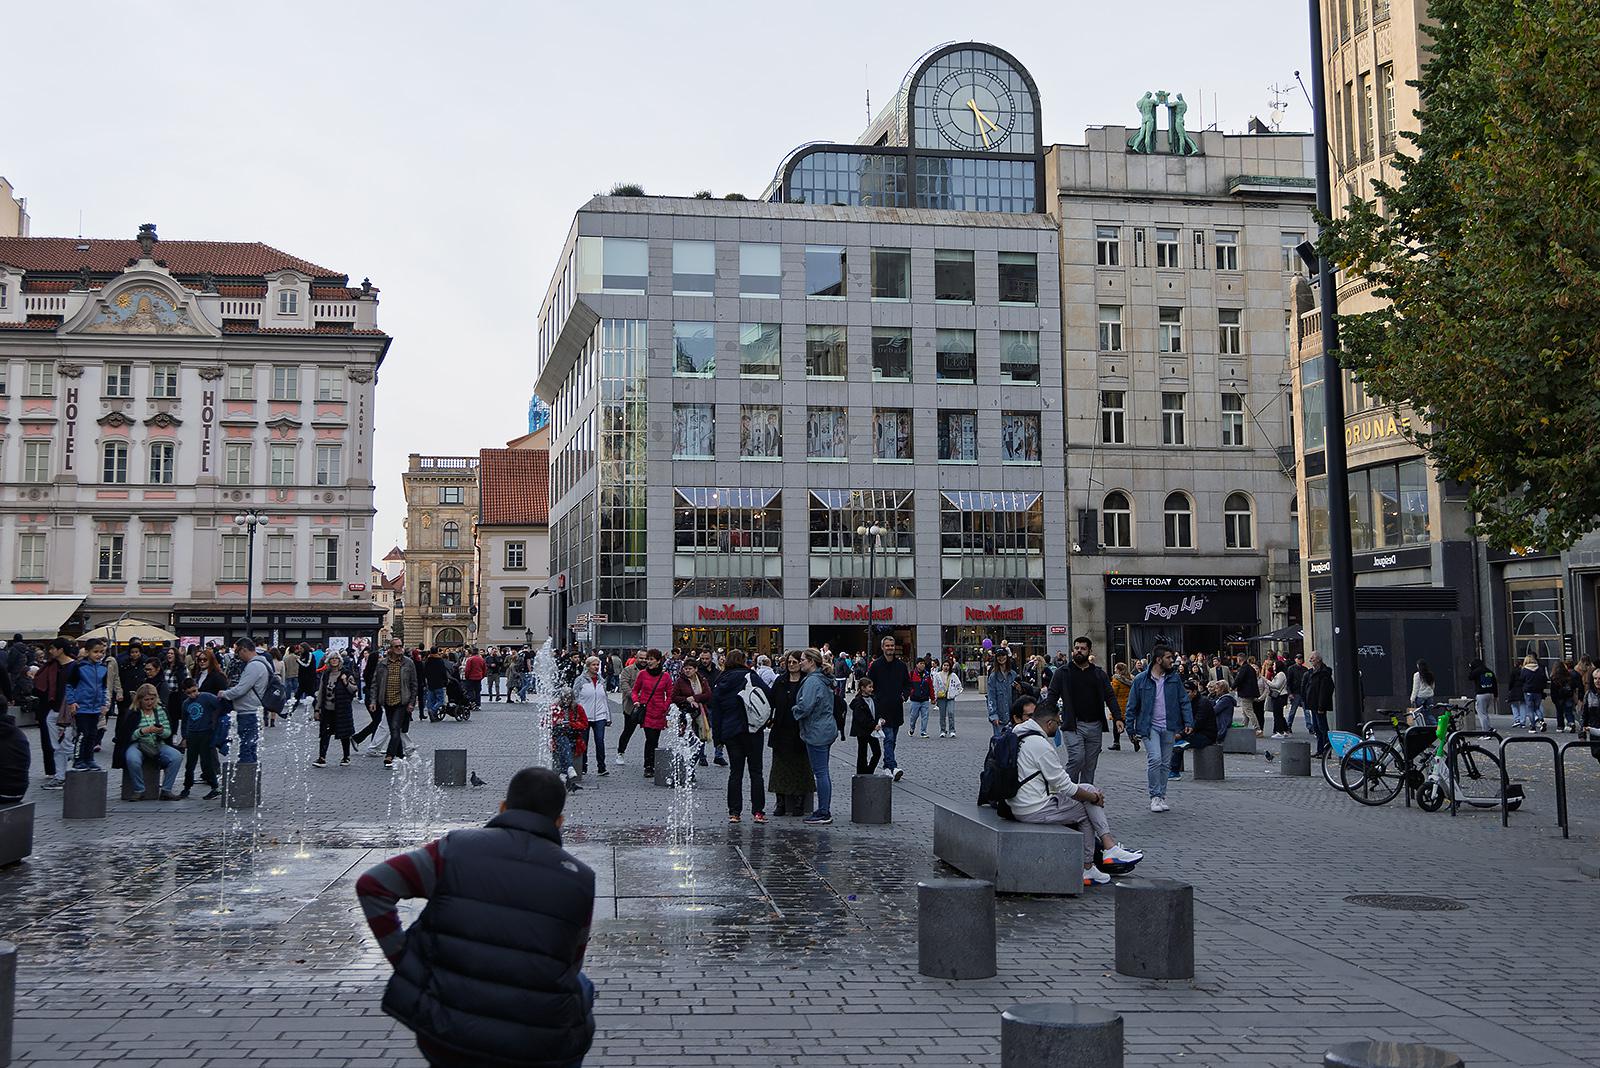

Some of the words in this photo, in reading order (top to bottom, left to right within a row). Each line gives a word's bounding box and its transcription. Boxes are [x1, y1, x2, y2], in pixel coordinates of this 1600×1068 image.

[65, 388, 79, 470] HOTEL
[202, 391, 214, 472] HOTEL
[1345, 415, 1398, 446] ORUNA
[1110, 578, 1143, 586] COFFEE
[1146, 578, 1172, 586] TODAY
[1177, 578, 1218, 587] COCKTAIL
[1220, 578, 1256, 587] TONIGHT
[1144, 602, 1179, 621] Pop
